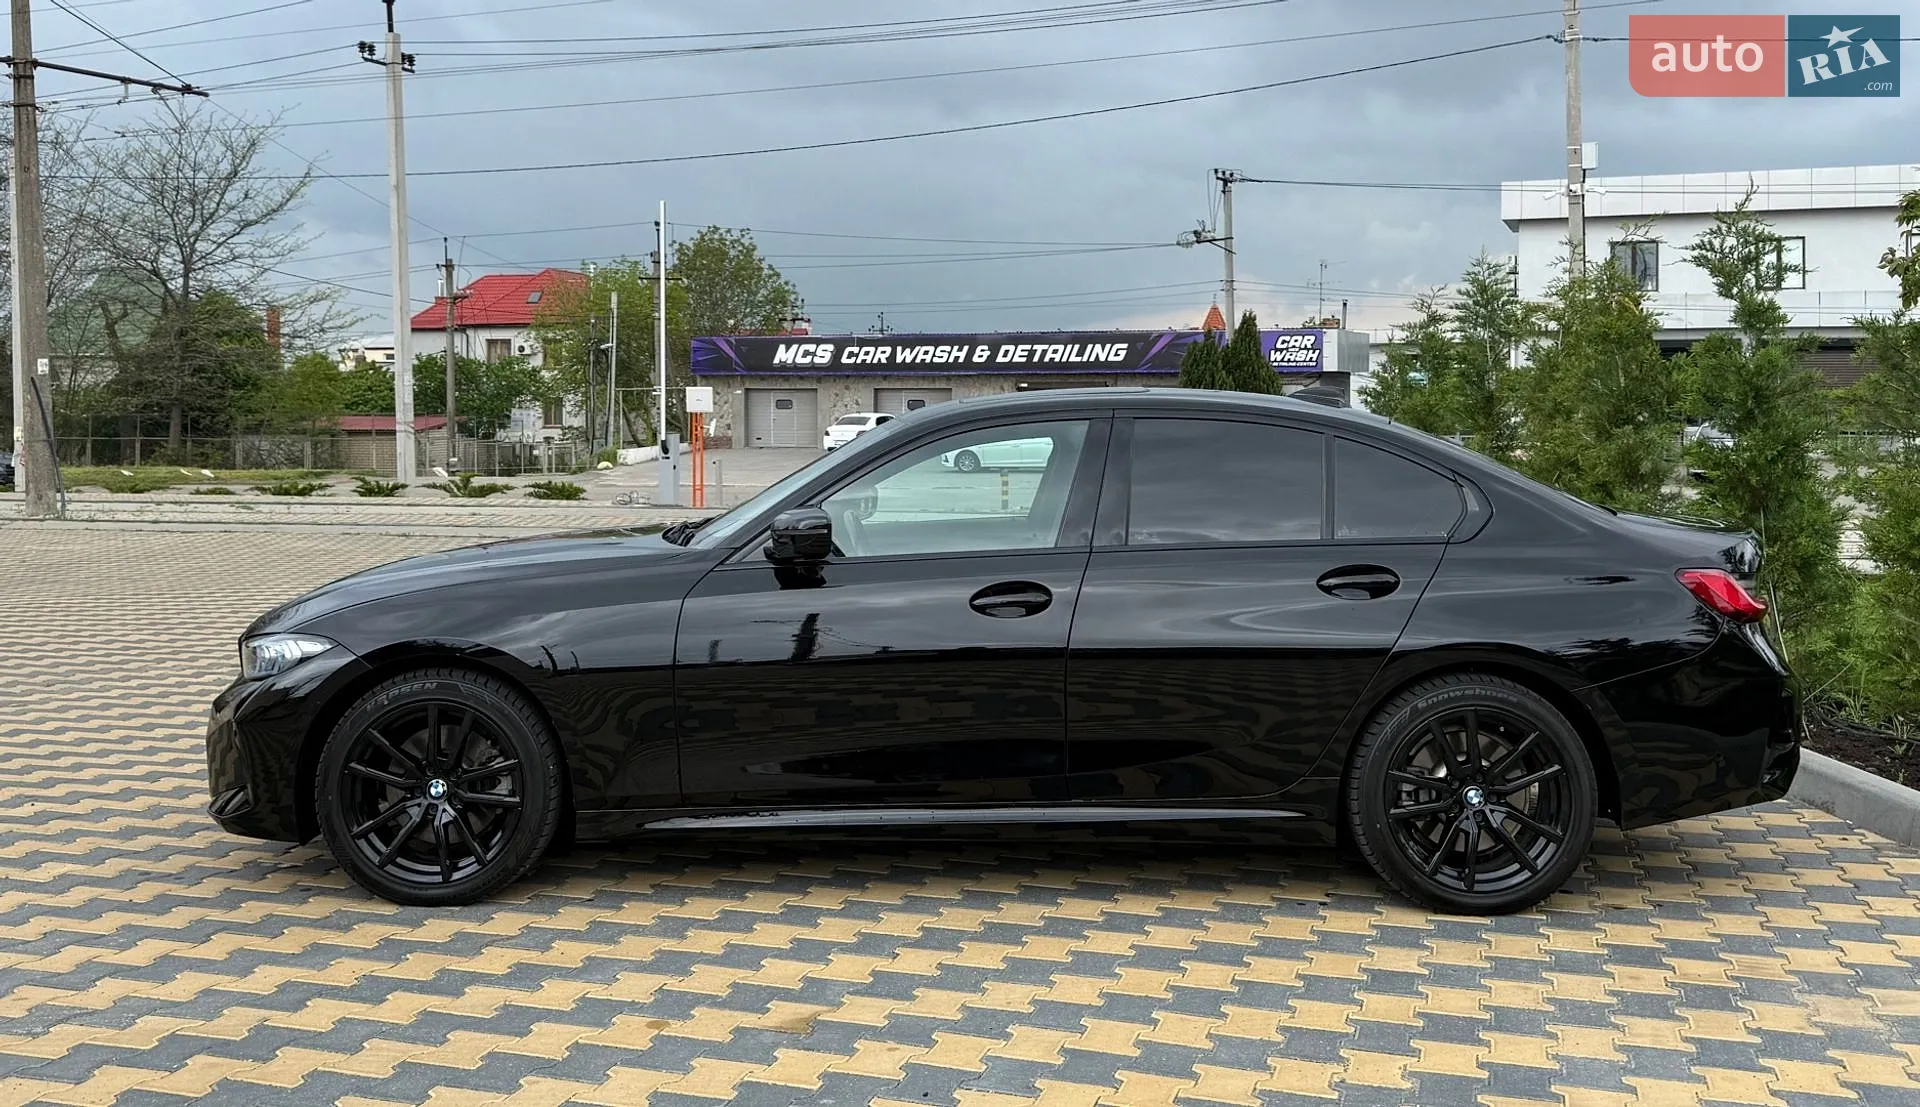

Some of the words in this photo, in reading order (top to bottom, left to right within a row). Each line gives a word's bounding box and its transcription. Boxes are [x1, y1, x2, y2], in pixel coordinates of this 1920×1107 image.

[1275, 335, 1316, 348] CAR
[772, 343, 835, 366] MCS
[840, 346, 892, 364] CAR
[895, 345, 970, 364] WASH
[972, 345, 991, 363] &
[995, 343, 1129, 363] DETAILING
[1270, 349, 1320, 361] WASH
